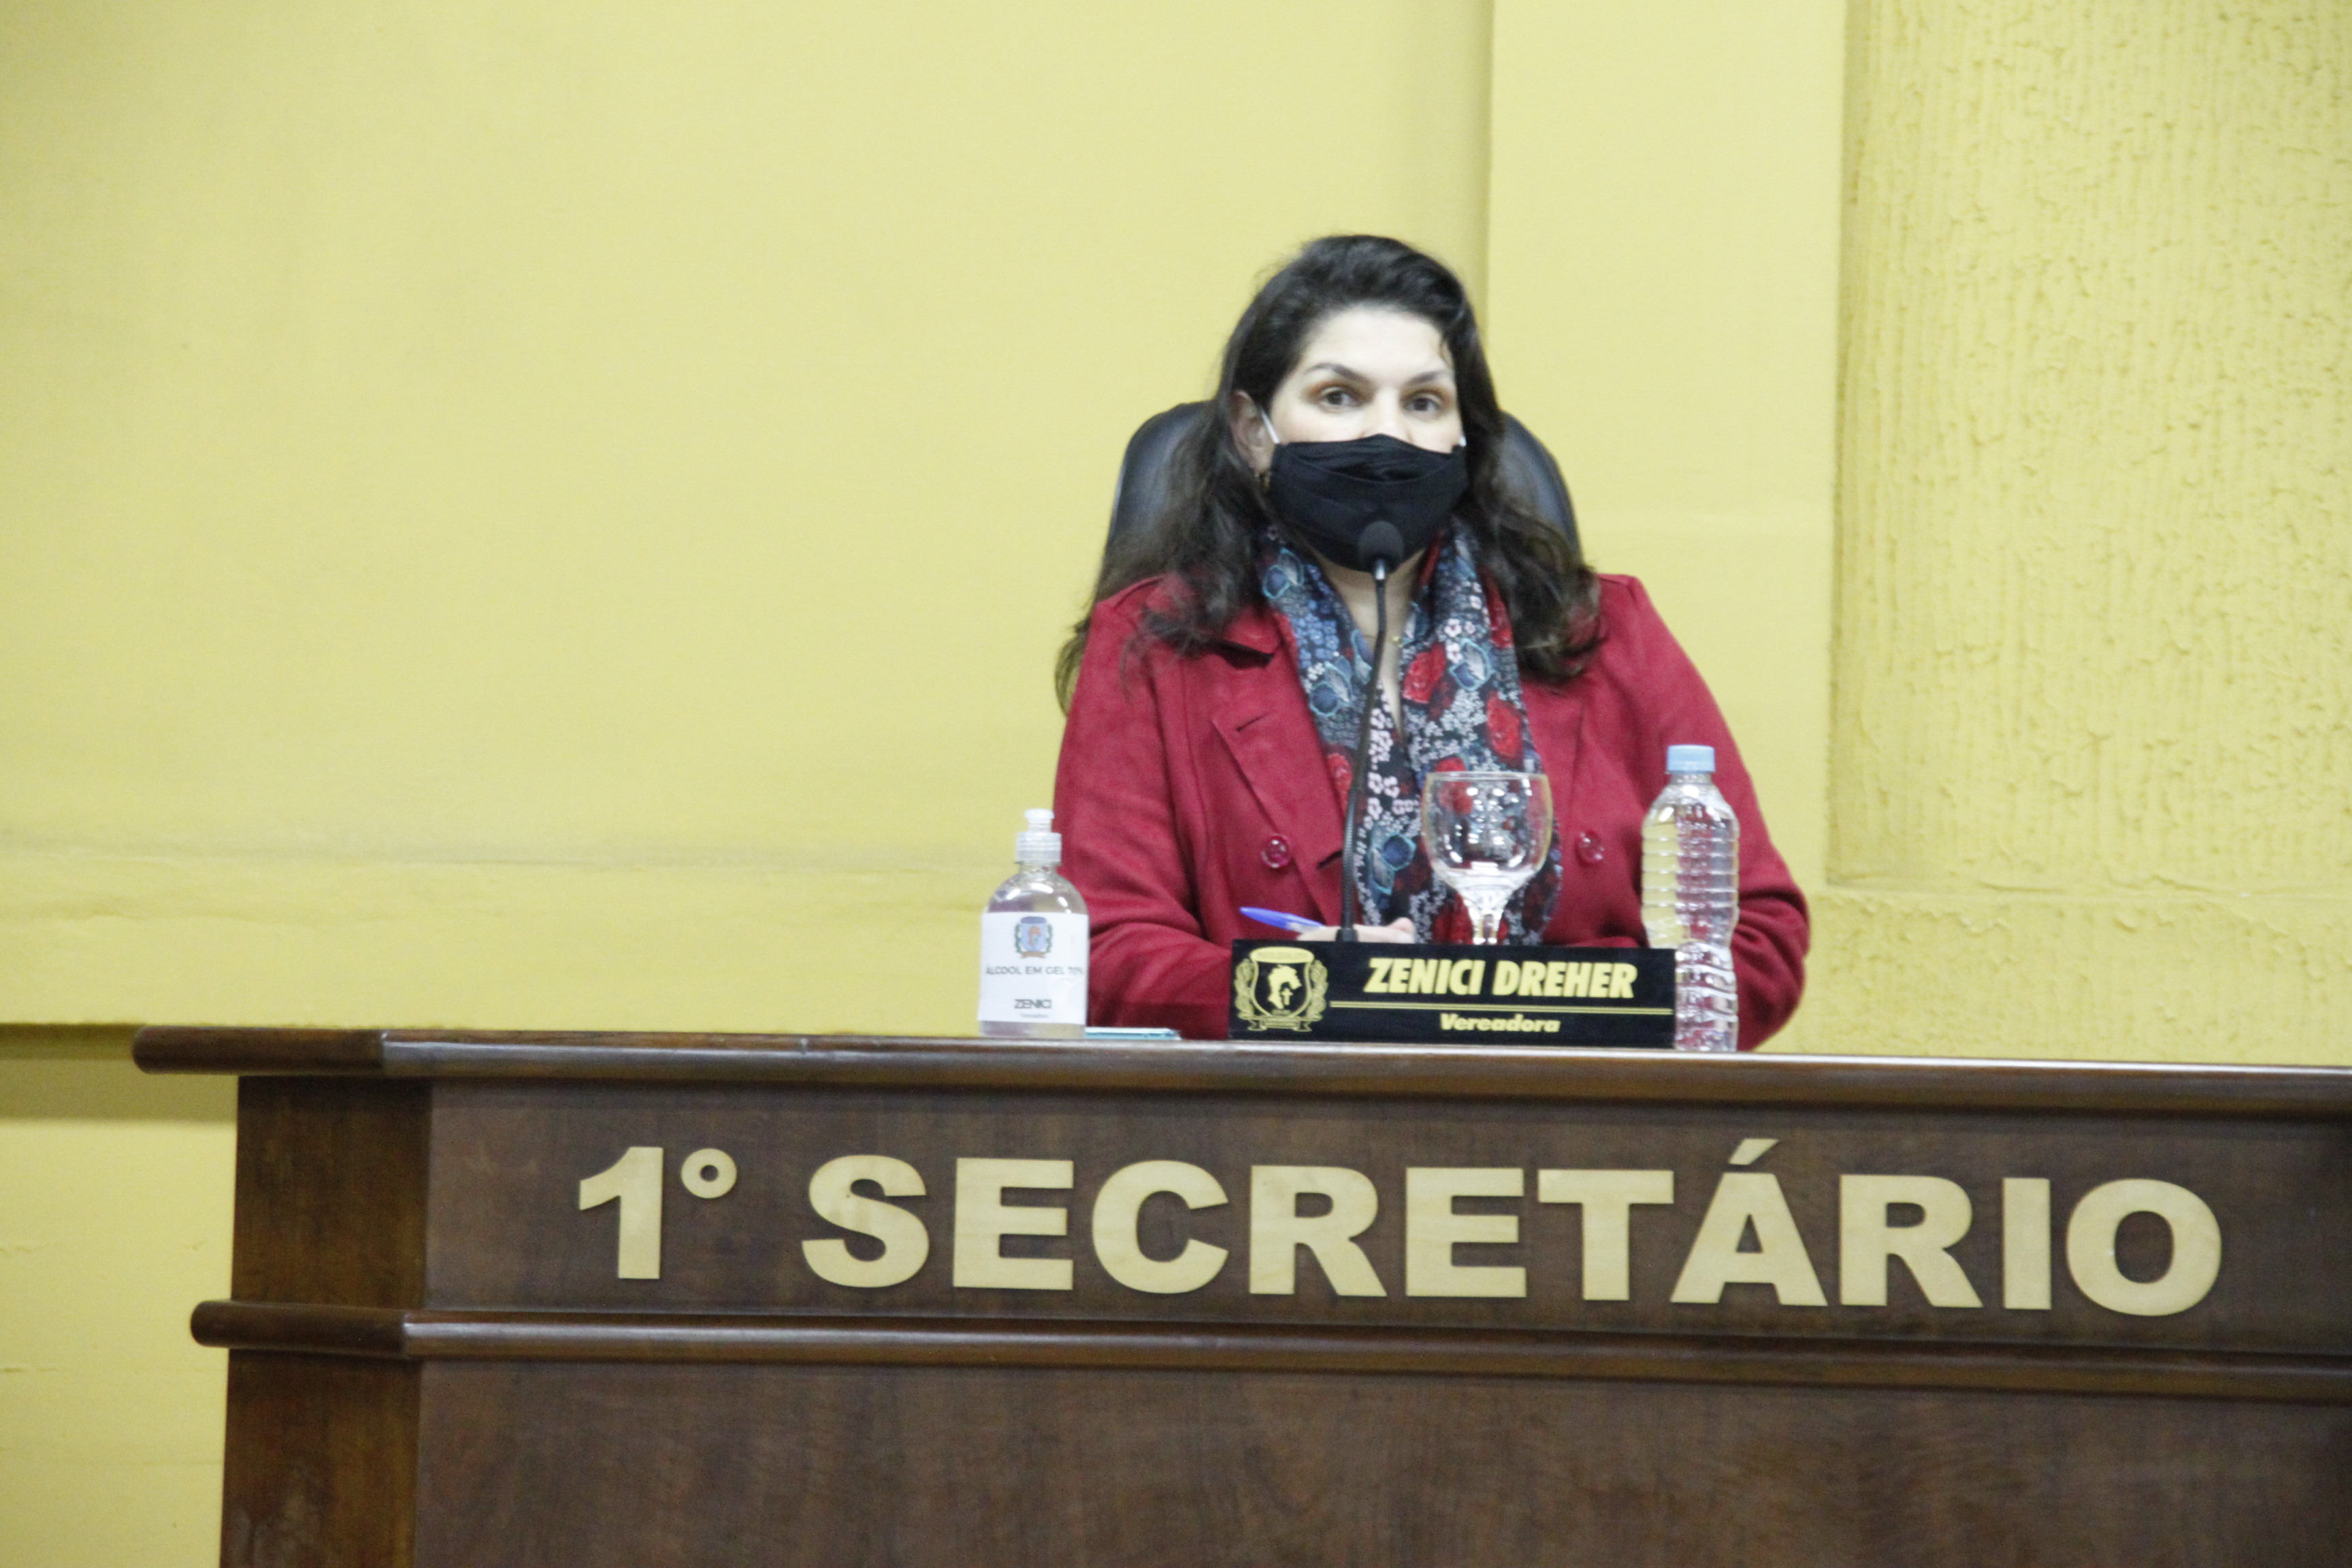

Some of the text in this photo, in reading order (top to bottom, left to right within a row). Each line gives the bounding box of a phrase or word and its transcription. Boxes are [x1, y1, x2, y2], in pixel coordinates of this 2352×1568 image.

[1026, 966, 1043, 975] EM
[1045, 966, 1064, 975] GEL
[1363, 958, 1638, 998] ZENICI DREHER
[1013, 998, 1052, 1009] ZENICI
[1440, 1013, 1561, 1032] Vereadora
[802, 1139, 2221, 1316] SECRETÁRIO
